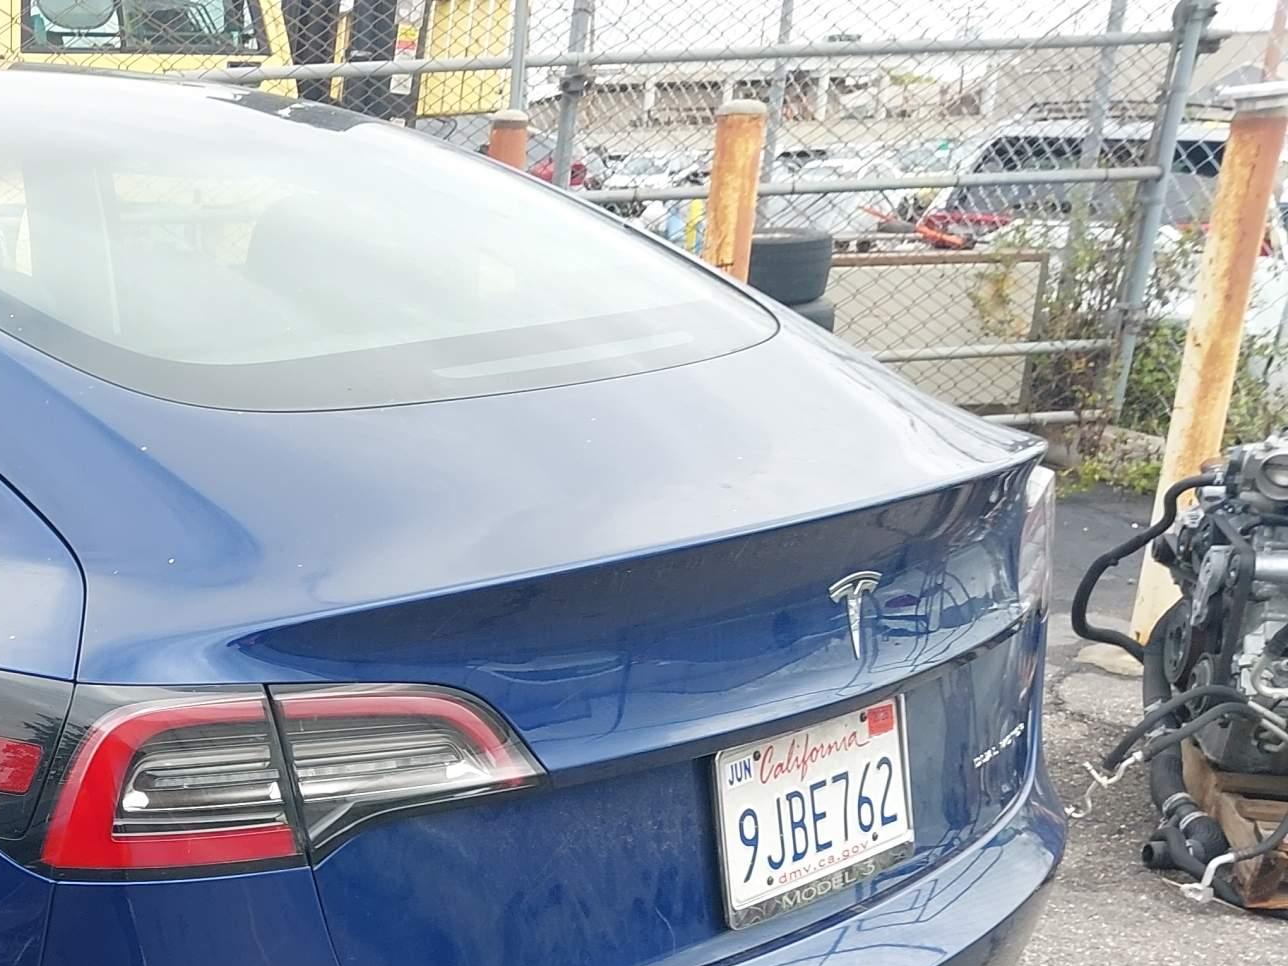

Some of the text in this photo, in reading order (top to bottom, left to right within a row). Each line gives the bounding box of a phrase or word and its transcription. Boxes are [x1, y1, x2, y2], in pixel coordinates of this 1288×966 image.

[728, 757, 753, 786] JUN
[760, 728, 869, 784] California
[738, 756, 898, 883] 9JBE762
[778, 841, 869, 884] dmv.ca.gov
[781, 860, 876, 910] MODEL 3
